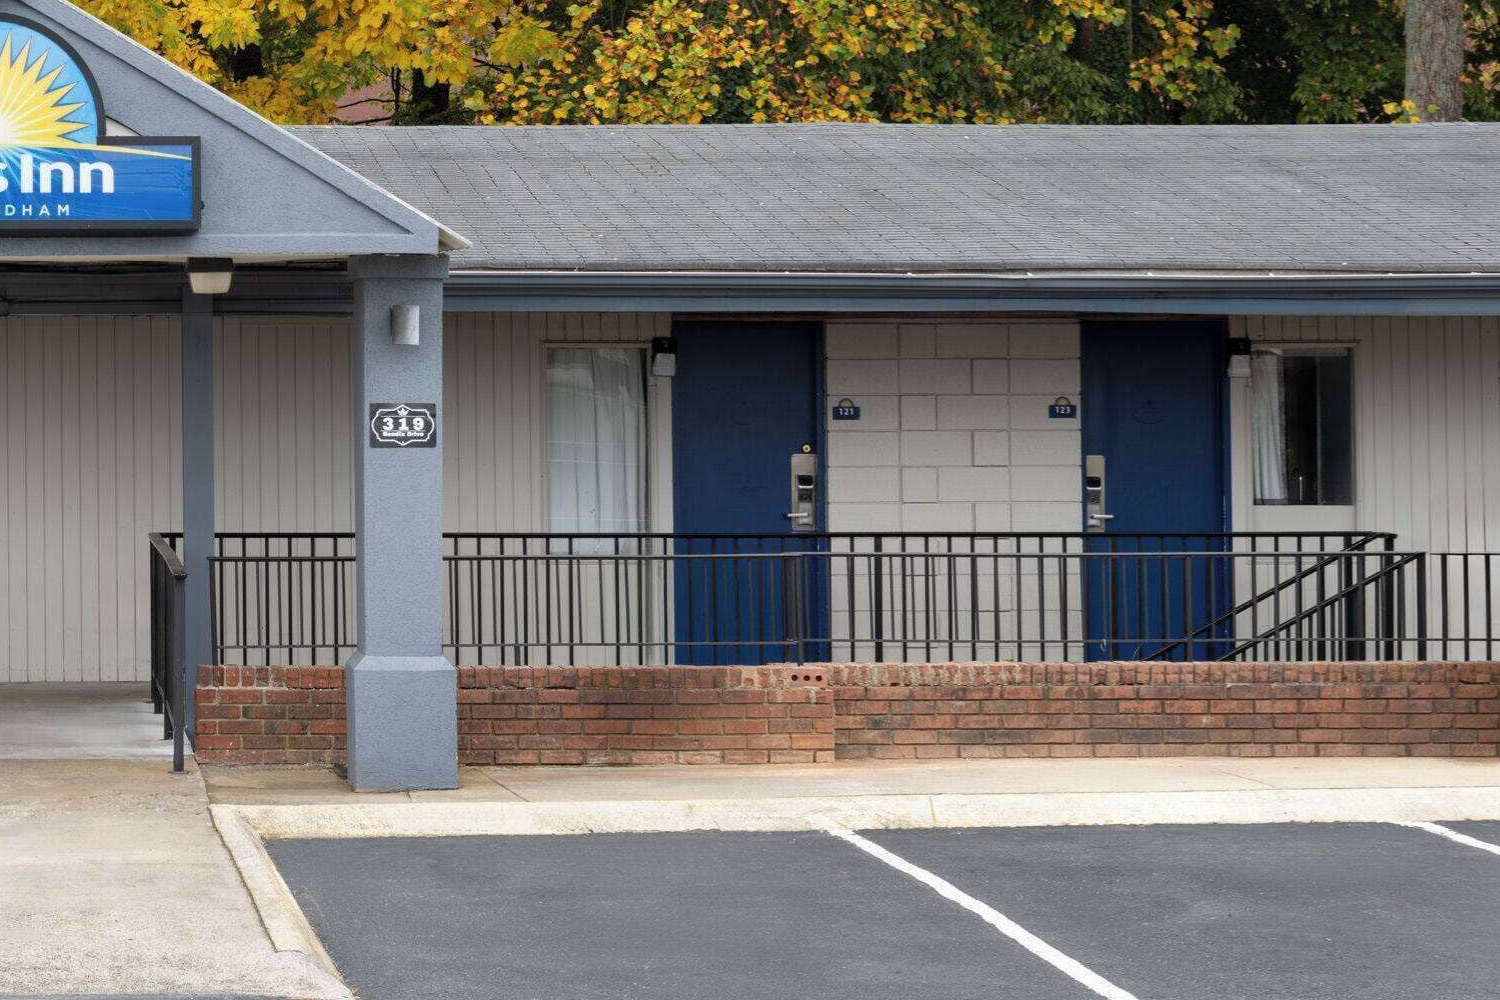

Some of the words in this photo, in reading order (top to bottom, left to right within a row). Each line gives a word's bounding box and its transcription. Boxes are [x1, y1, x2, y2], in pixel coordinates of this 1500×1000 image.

[20, 153, 115, 194] Inn
[1055, 406, 1071, 414] 123
[382, 417, 425, 431] 319
